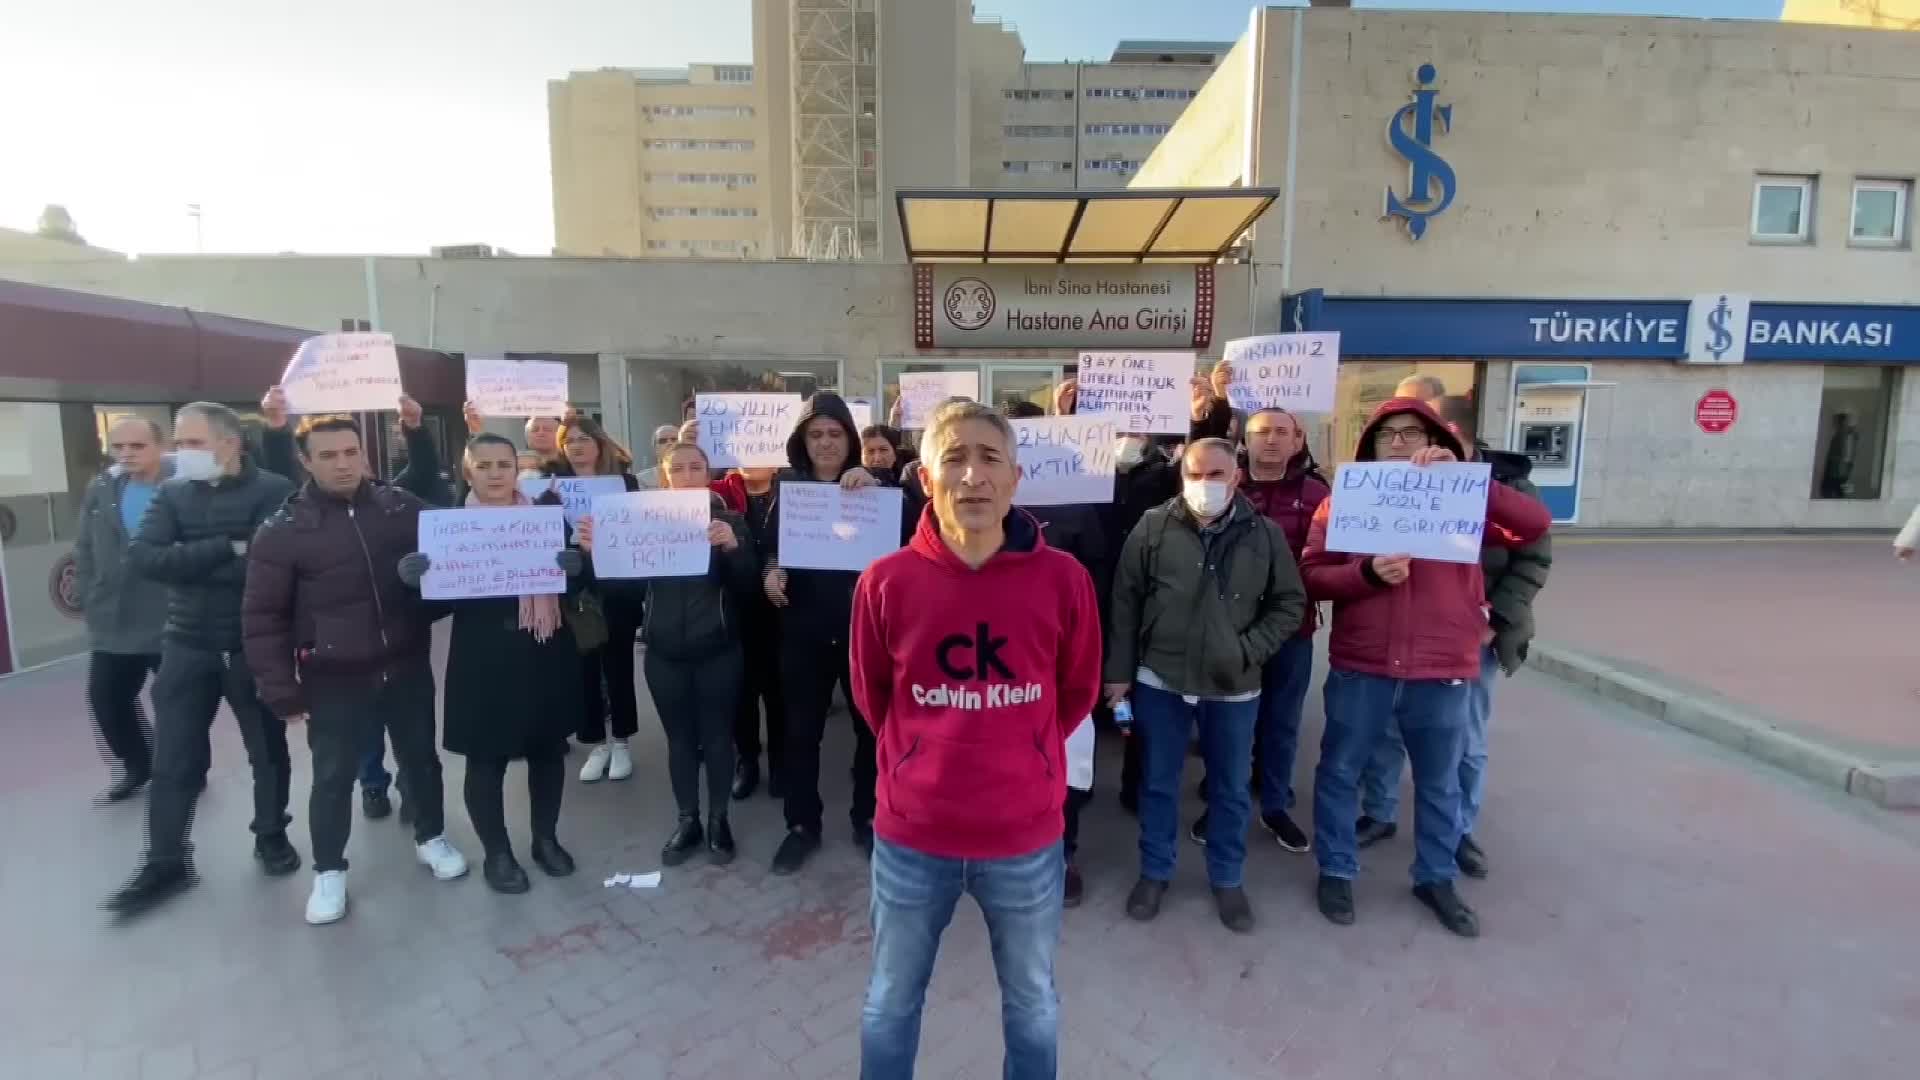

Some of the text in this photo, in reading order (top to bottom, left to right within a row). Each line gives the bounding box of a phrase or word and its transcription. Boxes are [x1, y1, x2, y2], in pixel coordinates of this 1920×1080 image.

[1058, 279, 1092, 295] Sina
[1096, 279, 1171, 295] Hastanesi
[1007, 308, 1187, 334] Hastane Ana Girişi
[1529, 312, 1679, 343] TÜRKİYE
[1749, 320, 1893, 345] BANKASI
[1083, 355, 1092, 369] 9
[699, 400, 729, 416] 20
[1129, 414, 1175, 430] EYT
[912, 682, 1042, 710] Calvin Klein
